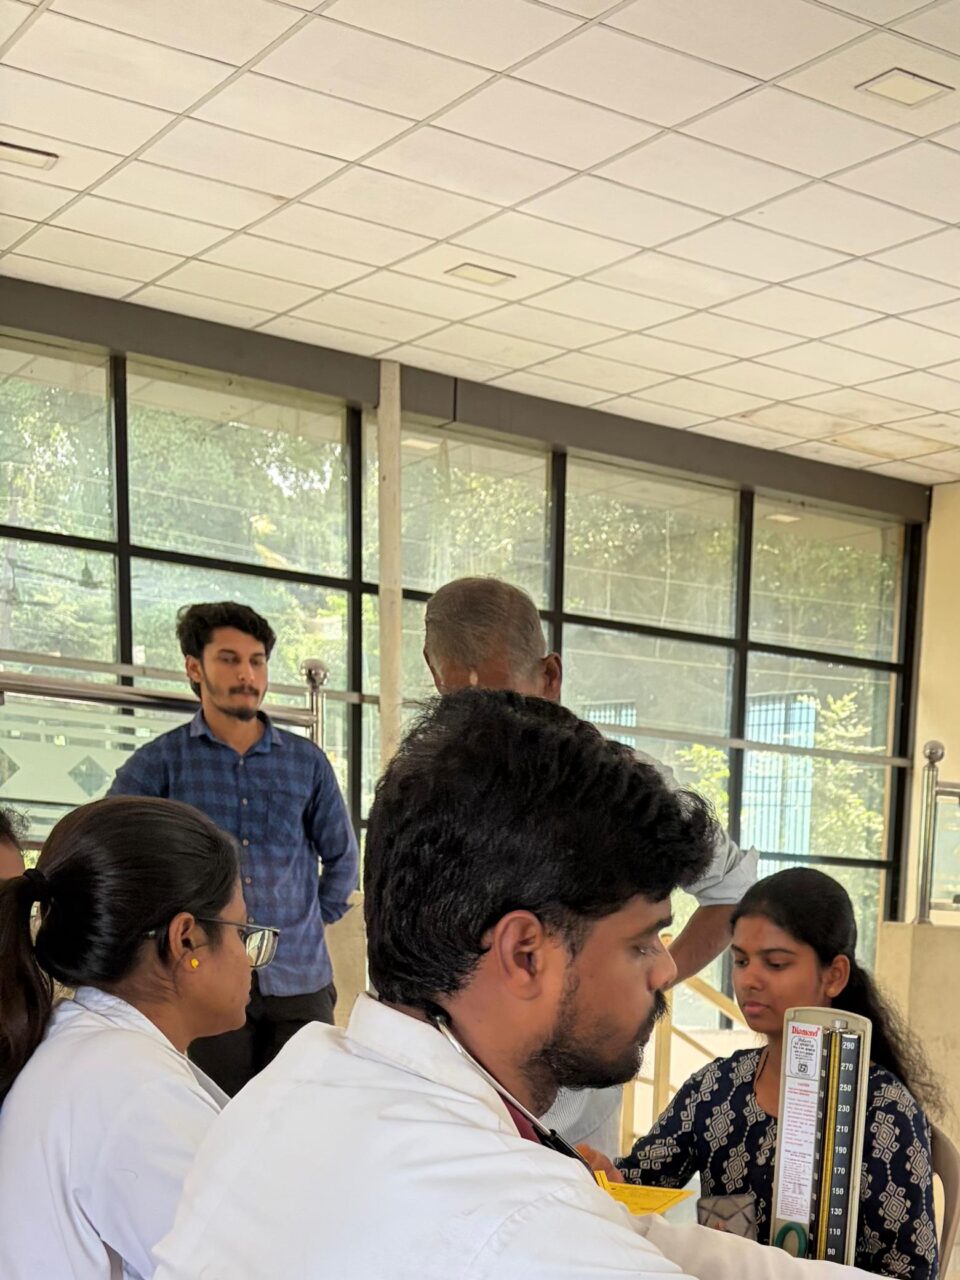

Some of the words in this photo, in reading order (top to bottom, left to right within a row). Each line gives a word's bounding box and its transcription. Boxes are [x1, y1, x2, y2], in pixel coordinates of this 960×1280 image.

[792, 1025, 818, 1037] Diamond
[842, 1041, 855, 1050] 290
[841, 1062, 853, 1071] 270
[840, 1083, 852, 1092] 250
[837, 1104, 850, 1113] 230
[836, 1125, 849, 1134] 210
[835, 1146, 847, 1154] 190
[834, 1167, 846, 1175] 170
[832, 1187, 844, 1195] 150
[831, 1207, 843, 1216] 130
[829, 1227, 841, 1236] 110
[827, 1247, 836, 1256] 90
